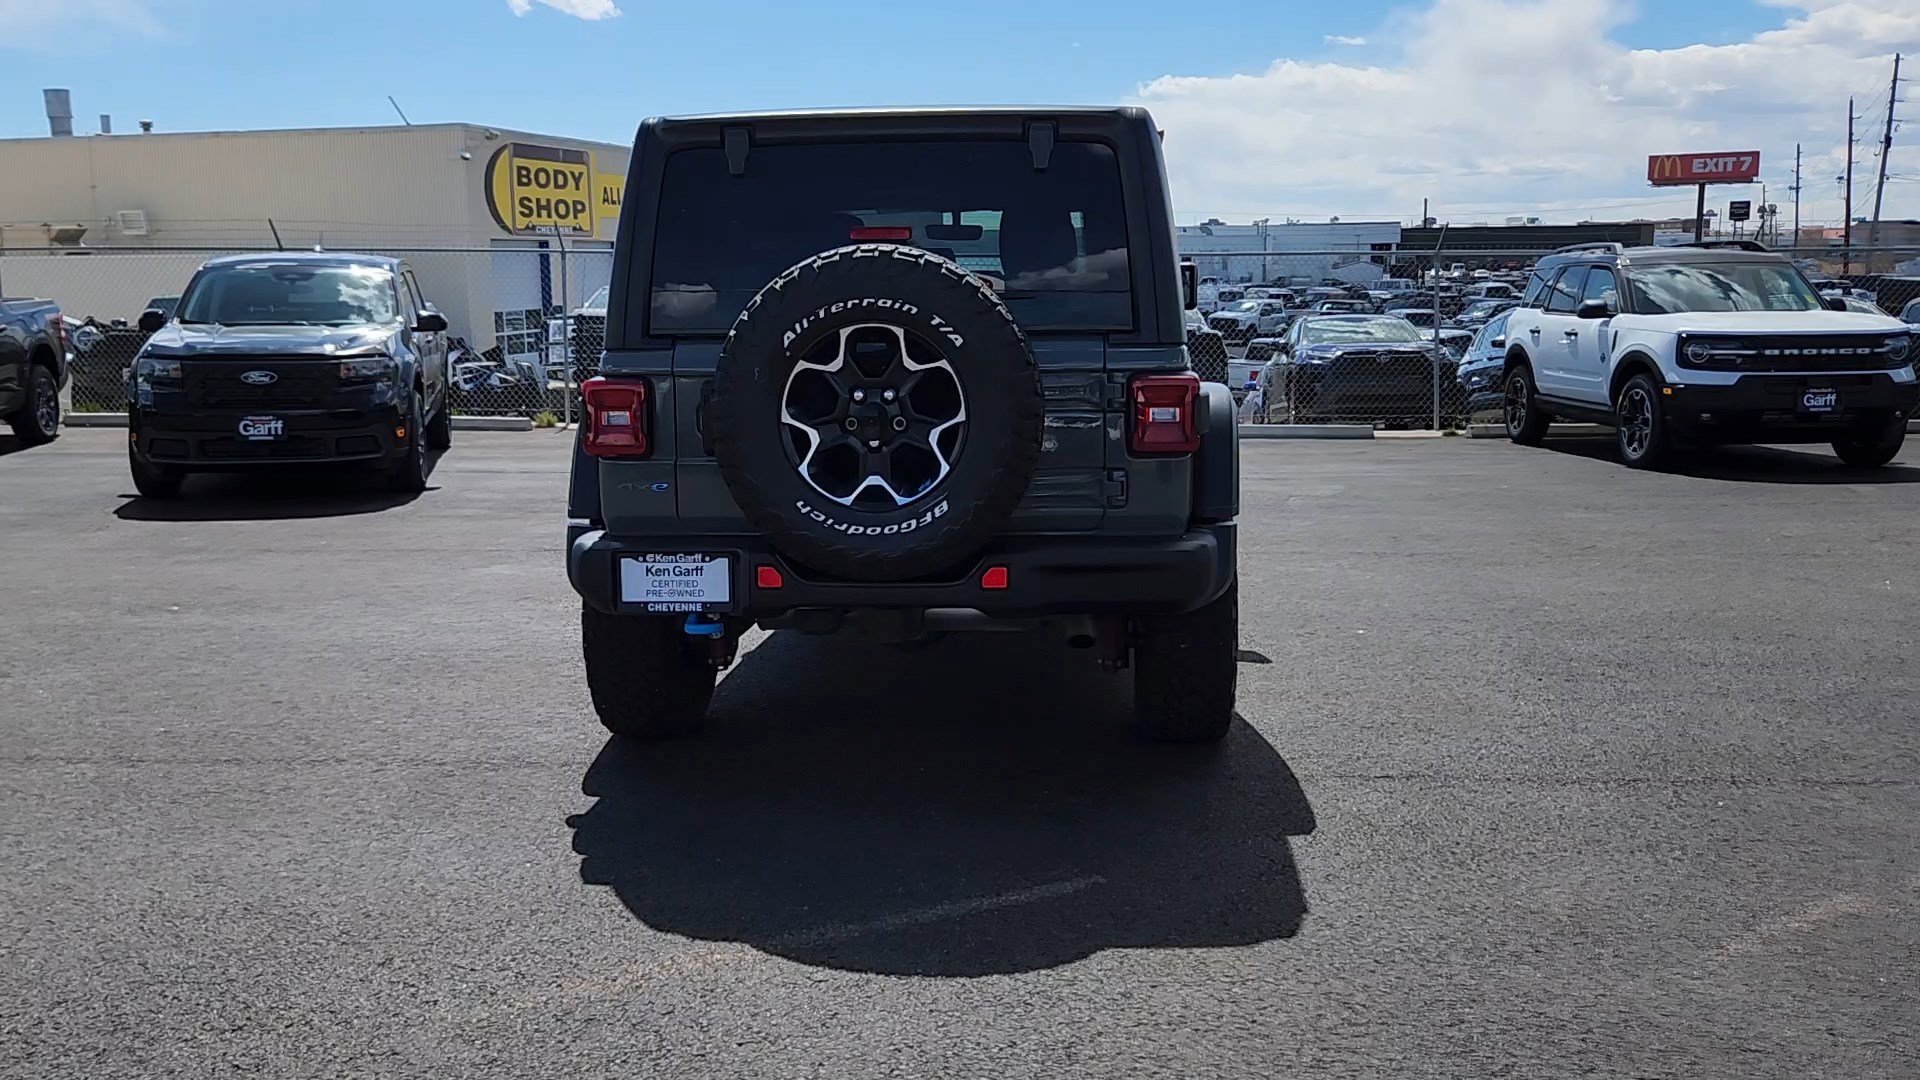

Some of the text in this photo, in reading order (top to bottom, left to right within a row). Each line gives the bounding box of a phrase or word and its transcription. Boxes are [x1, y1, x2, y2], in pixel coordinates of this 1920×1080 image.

[1692, 156, 1753, 173] EXIT 7
[516, 165, 584, 191] BODY
[518, 196, 586, 219] SHOP
[782, 298, 964, 348] All-Terrain T/A
[1803, 394, 1836, 406] Garff
[239, 420, 284, 435] Garff
[796, 500, 949, 535] BFGoodrich
[655, 553, 703, 562] Ken Garff
[645, 565, 704, 577] Ken Garff
[651, 580, 699, 588] CERTIFIED
[646, 589, 705, 597] PRE-OWNED
[648, 603, 703, 611] CHEYENNE
